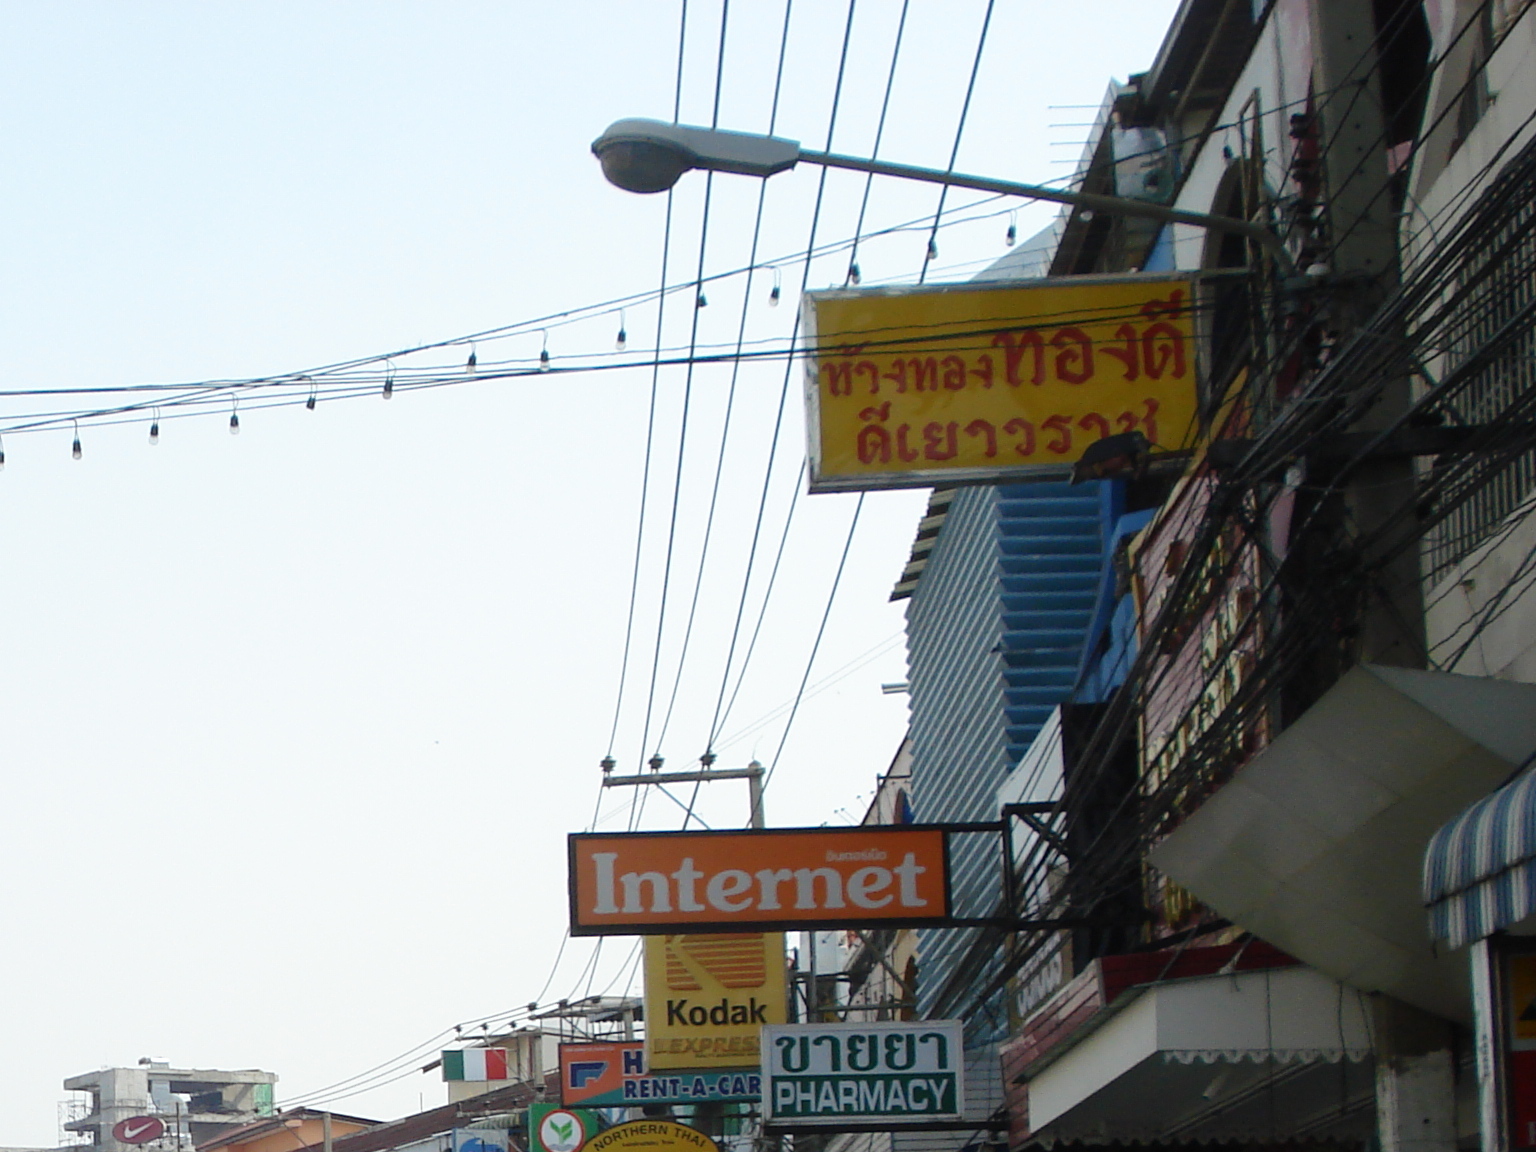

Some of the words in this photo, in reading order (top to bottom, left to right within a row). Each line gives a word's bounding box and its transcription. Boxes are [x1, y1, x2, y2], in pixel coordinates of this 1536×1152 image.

[592, 851, 928, 914] Internet
[667, 998, 767, 1026] Kodak
[667, 1036, 761, 1054] EXPRES
[775, 1032, 948, 1073] ขายยา
[624, 1050, 645, 1075] H
[624, 1074, 762, 1100] RENT-A-CAR
[776, 1078, 949, 1114] PHARMACY
[593, 1124, 668, 1152] NORTHERN
[674, 1127, 706, 1148] THAI
